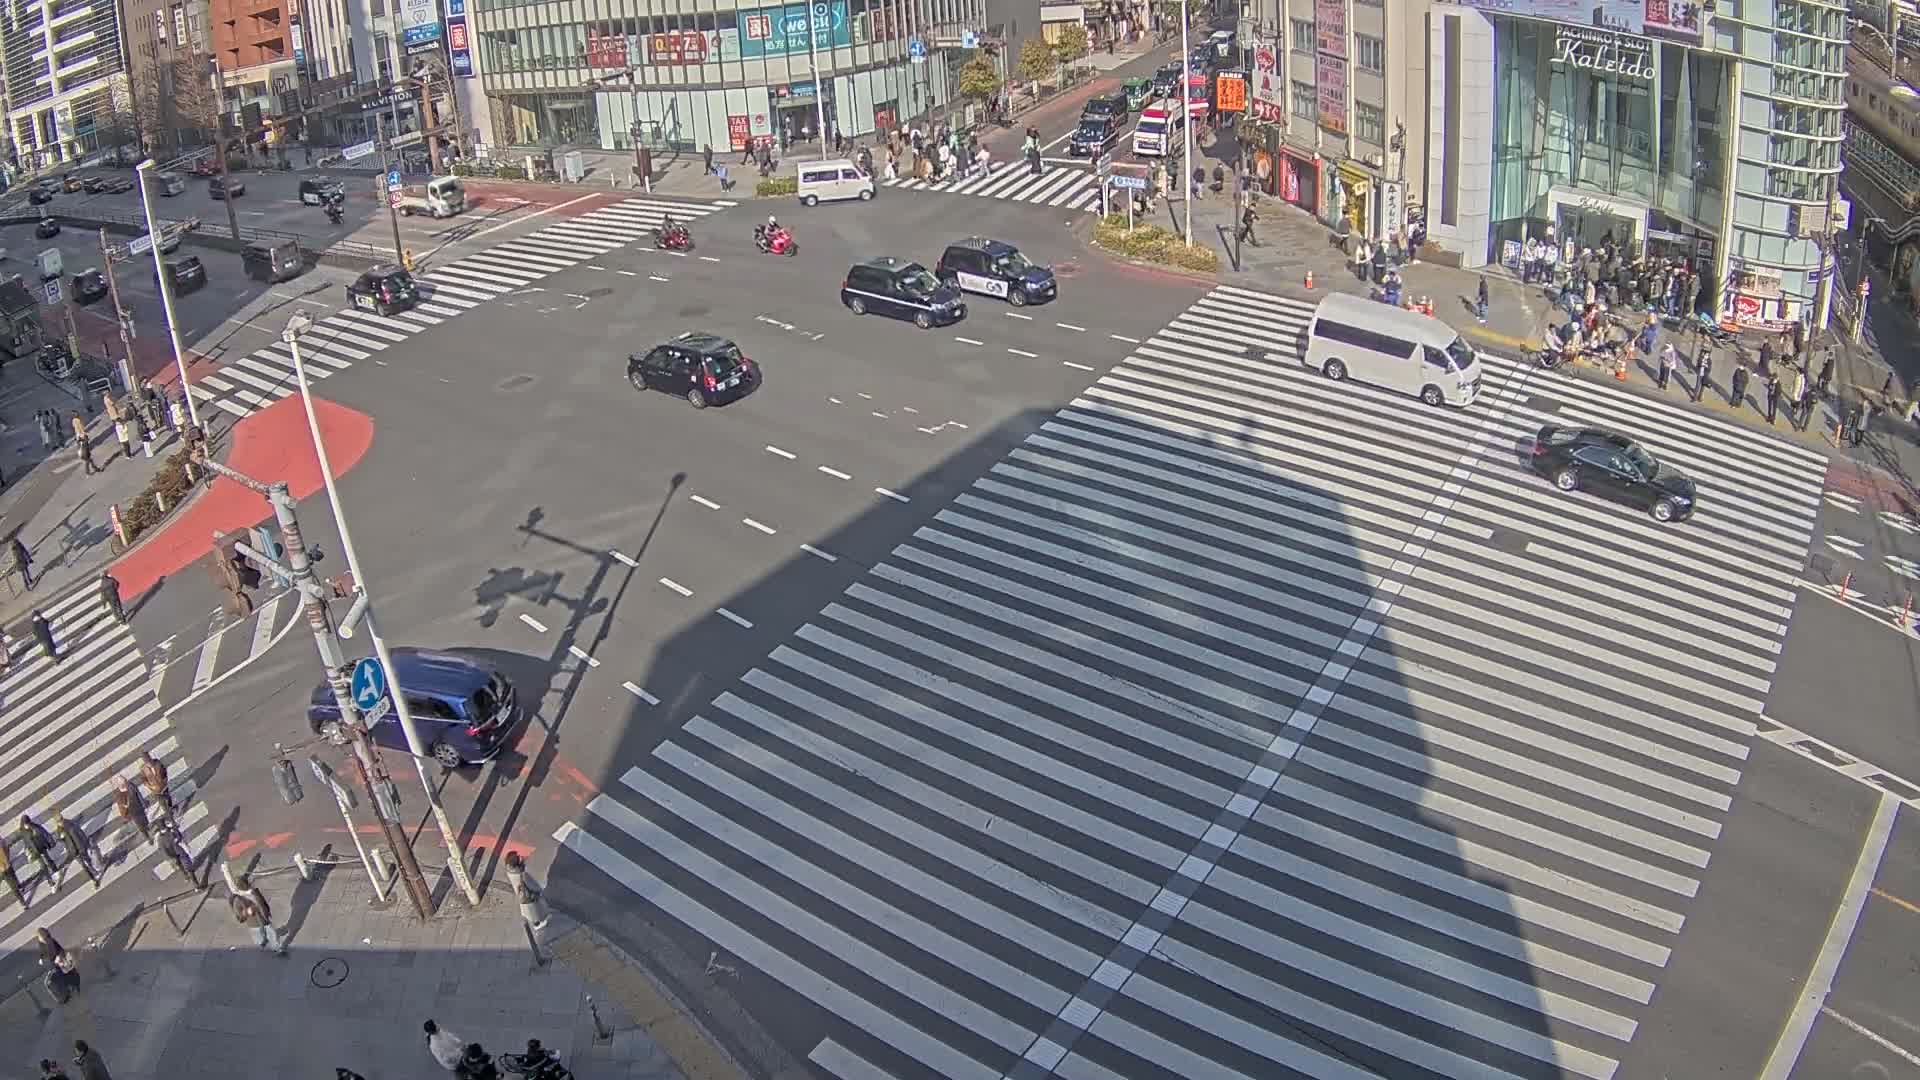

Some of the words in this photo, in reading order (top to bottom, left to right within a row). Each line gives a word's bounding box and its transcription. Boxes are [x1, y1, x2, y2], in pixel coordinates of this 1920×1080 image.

[1556, 26, 1612, 43] PACHINKO
[1624, 37, 1650, 52] SLOT
[1549, 38, 1656, 80] Kaleido
